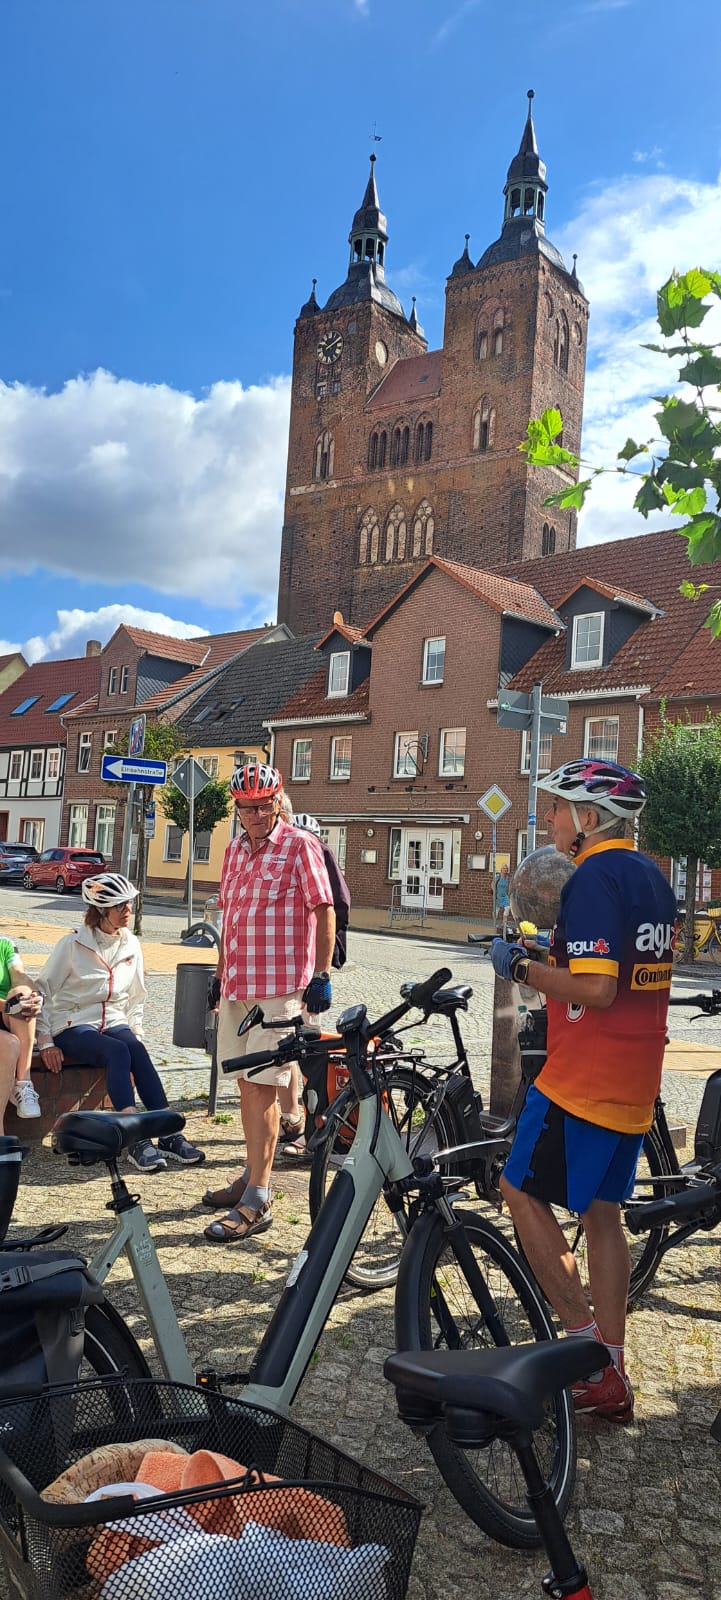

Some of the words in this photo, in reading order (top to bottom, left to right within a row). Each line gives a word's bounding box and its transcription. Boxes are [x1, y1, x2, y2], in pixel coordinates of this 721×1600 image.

[121, 766, 163, 776] Einbahnstraße
[566, 940, 594, 956] agu
[636, 922, 670, 959] agu
